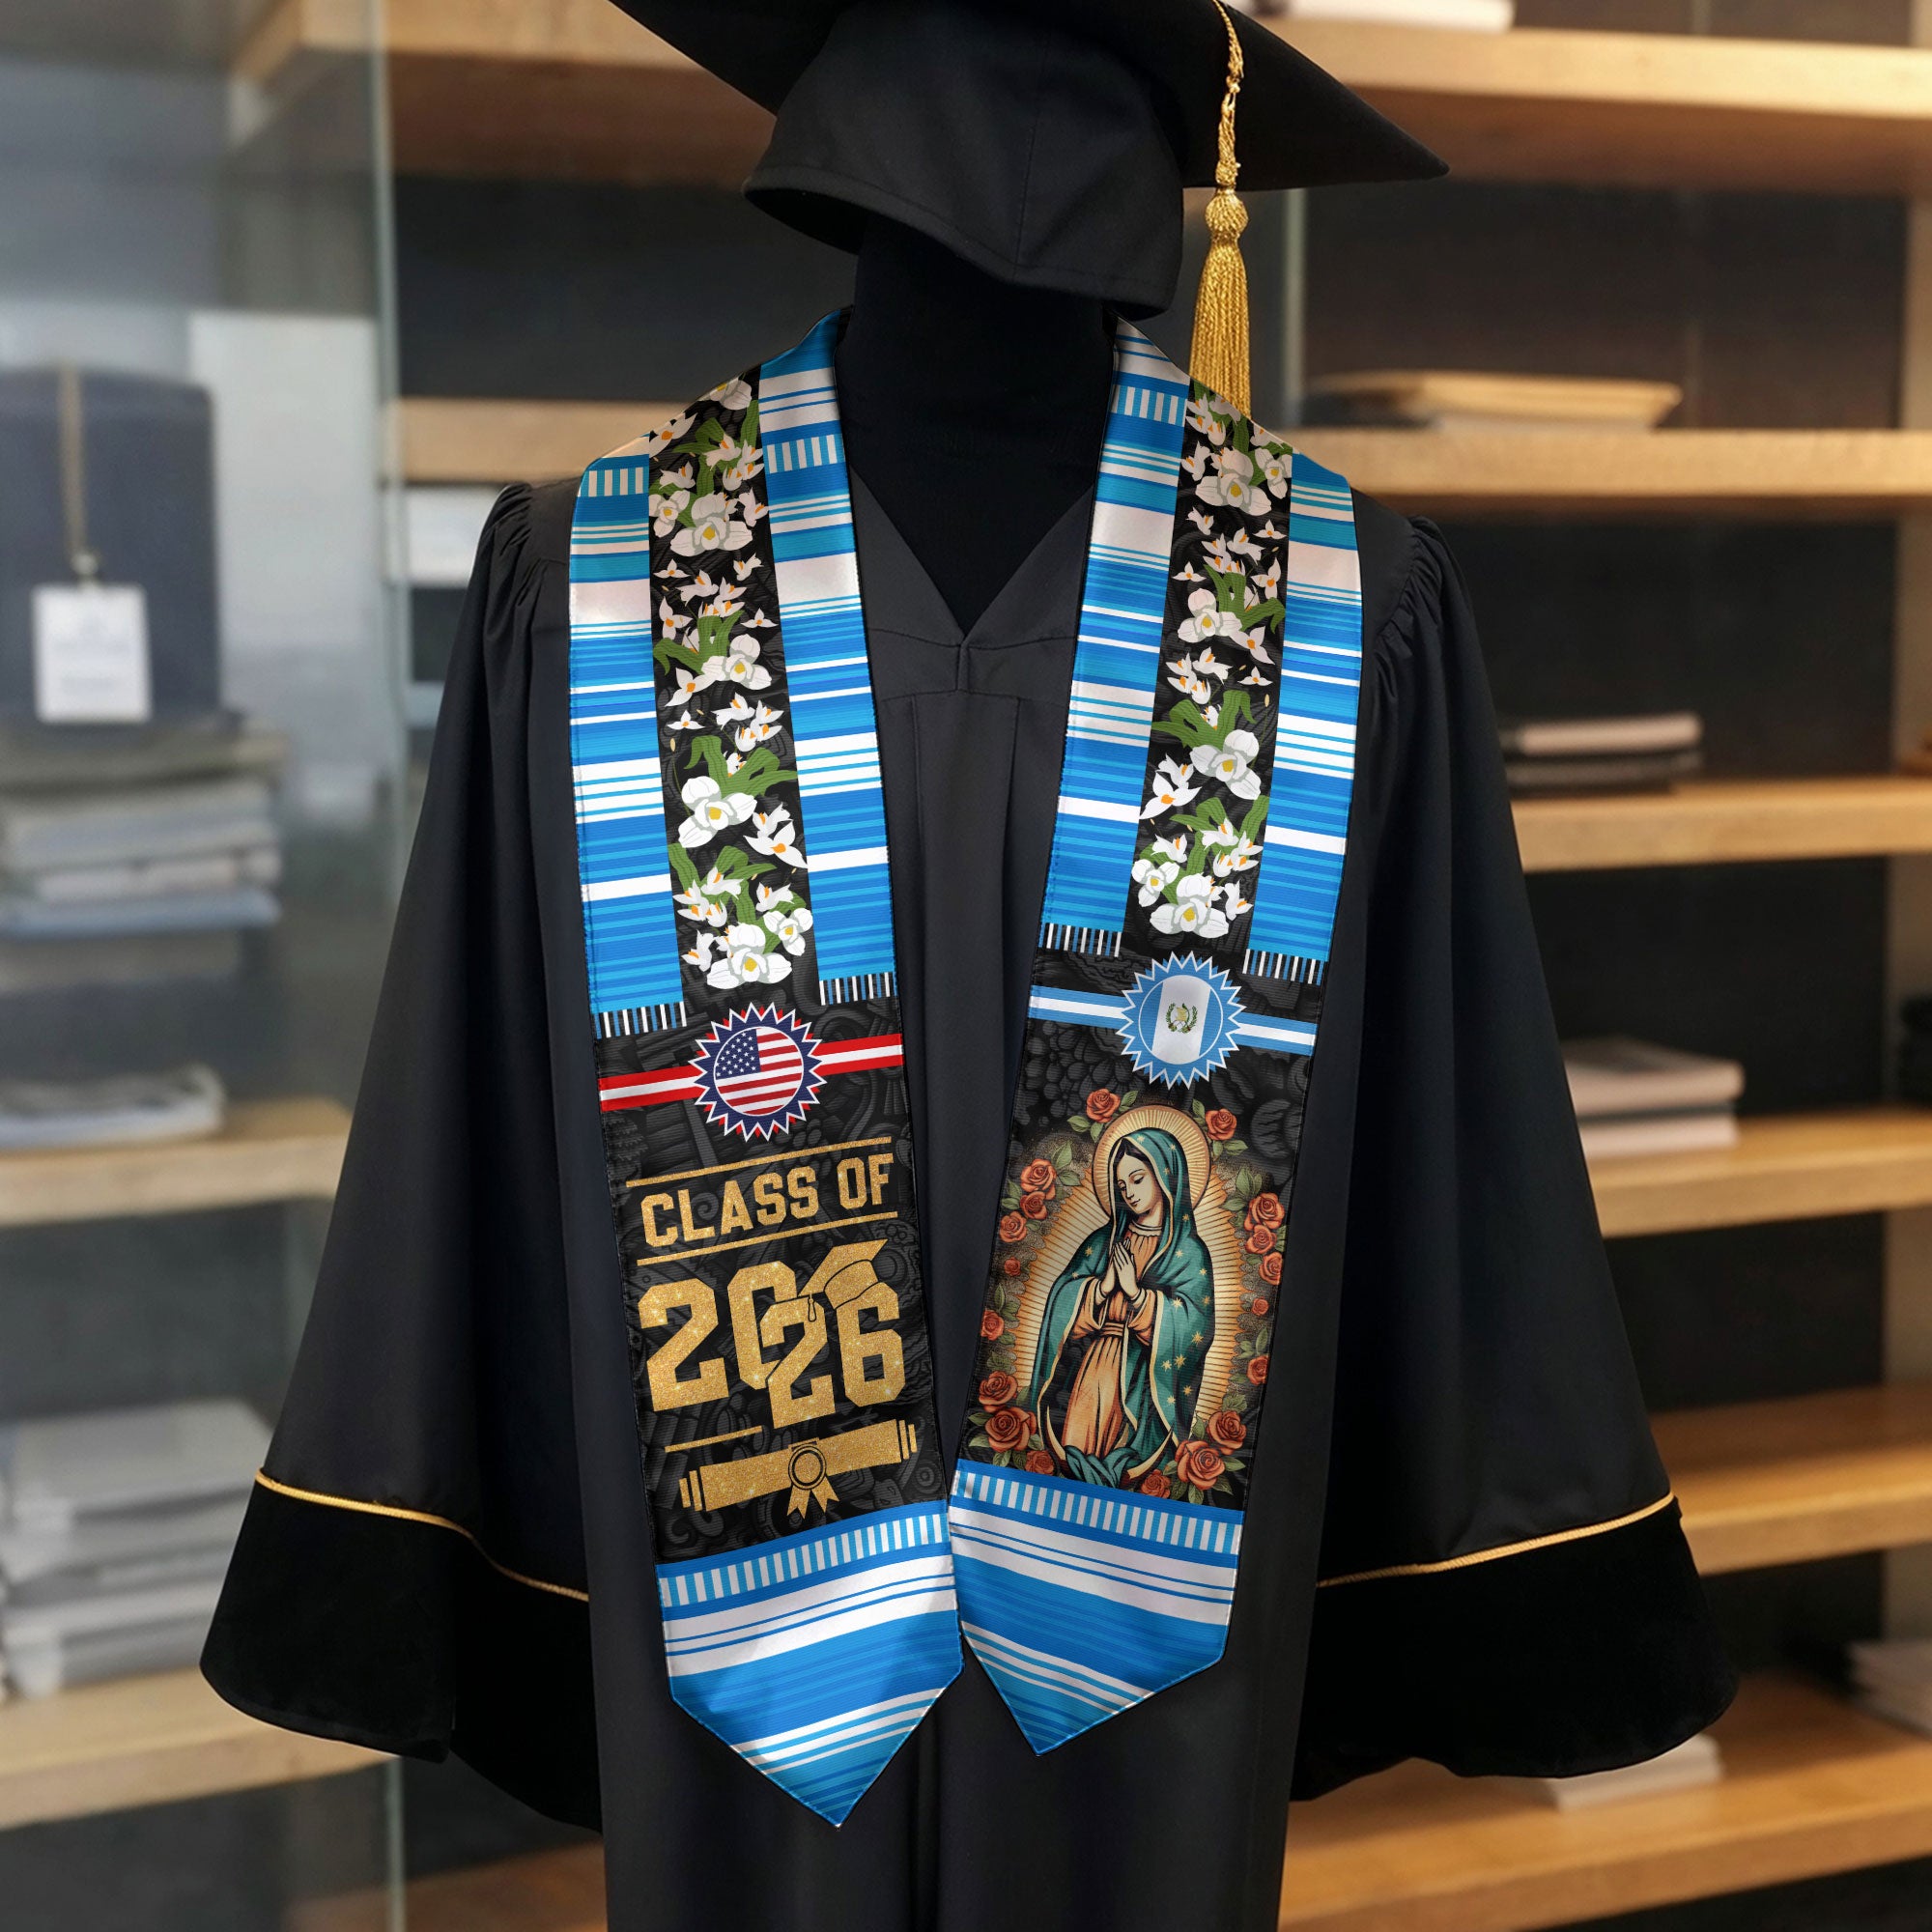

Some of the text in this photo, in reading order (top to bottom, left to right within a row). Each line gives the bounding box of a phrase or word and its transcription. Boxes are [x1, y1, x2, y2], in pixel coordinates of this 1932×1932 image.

[640, 1154, 894, 1247] CLASS OF
[638, 1261, 905, 1429] 2026
